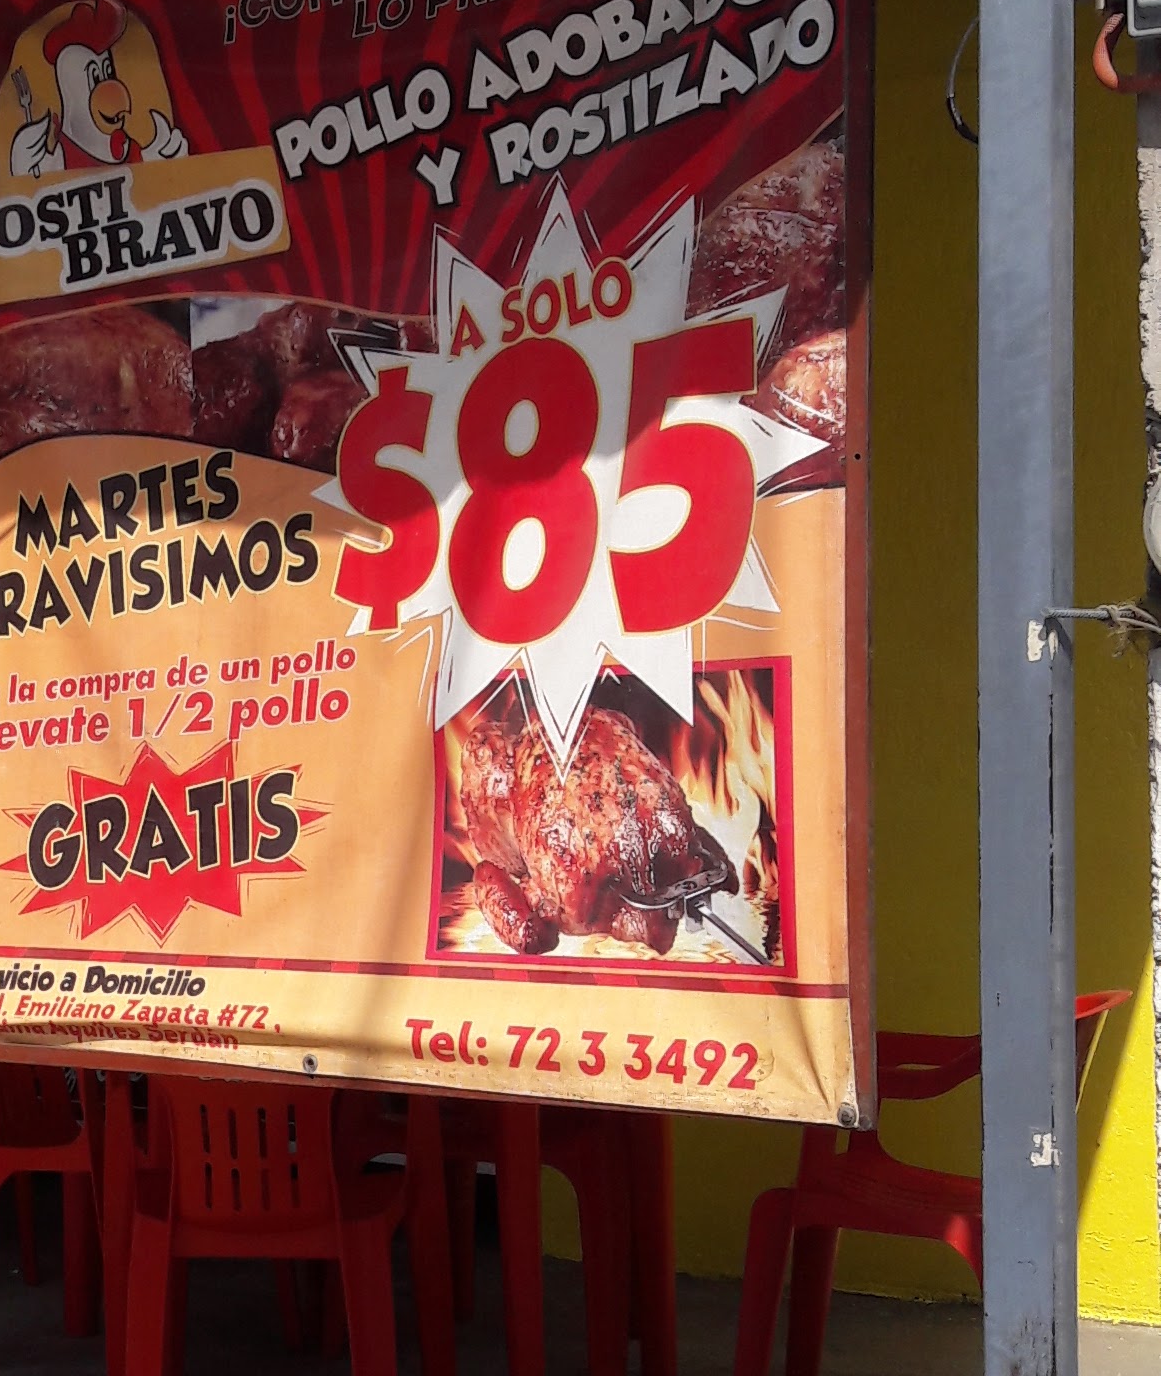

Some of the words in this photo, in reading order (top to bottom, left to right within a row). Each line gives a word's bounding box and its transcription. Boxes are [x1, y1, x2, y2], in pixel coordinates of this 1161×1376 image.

[277, 66, 451, 178] POLLO
[418, 149, 459, 206] Y
[65, 187, 277, 285] BRAVO
[450, 304, 485, 359] A
[501, 256, 633, 343] SOLO
[13, 451, 239, 557] MARTES
[331, 316, 758, 647] $85
[8, 676, 37, 705] la
[45, 665, 157, 701] compra
[167, 655, 210, 687] de
[221, 655, 261, 682] un
[269, 640, 357, 691] pollo
[127, 690, 215, 739] 1/2
[228, 680, 351, 741] pollo
[26, 771, 301, 891] GRATIS
[14, 994, 116, 1021] Emiliano
[120, 999, 208, 1026] Zapata
[59, 972, 76, 992] a
[83, 965, 206, 997] Domicilio
[404, 1018, 489, 1067] Tel:
[506, 1025, 561, 1073] 72
[577, 1030, 608, 1076] 3
[624, 1033, 759, 1091] 3492
